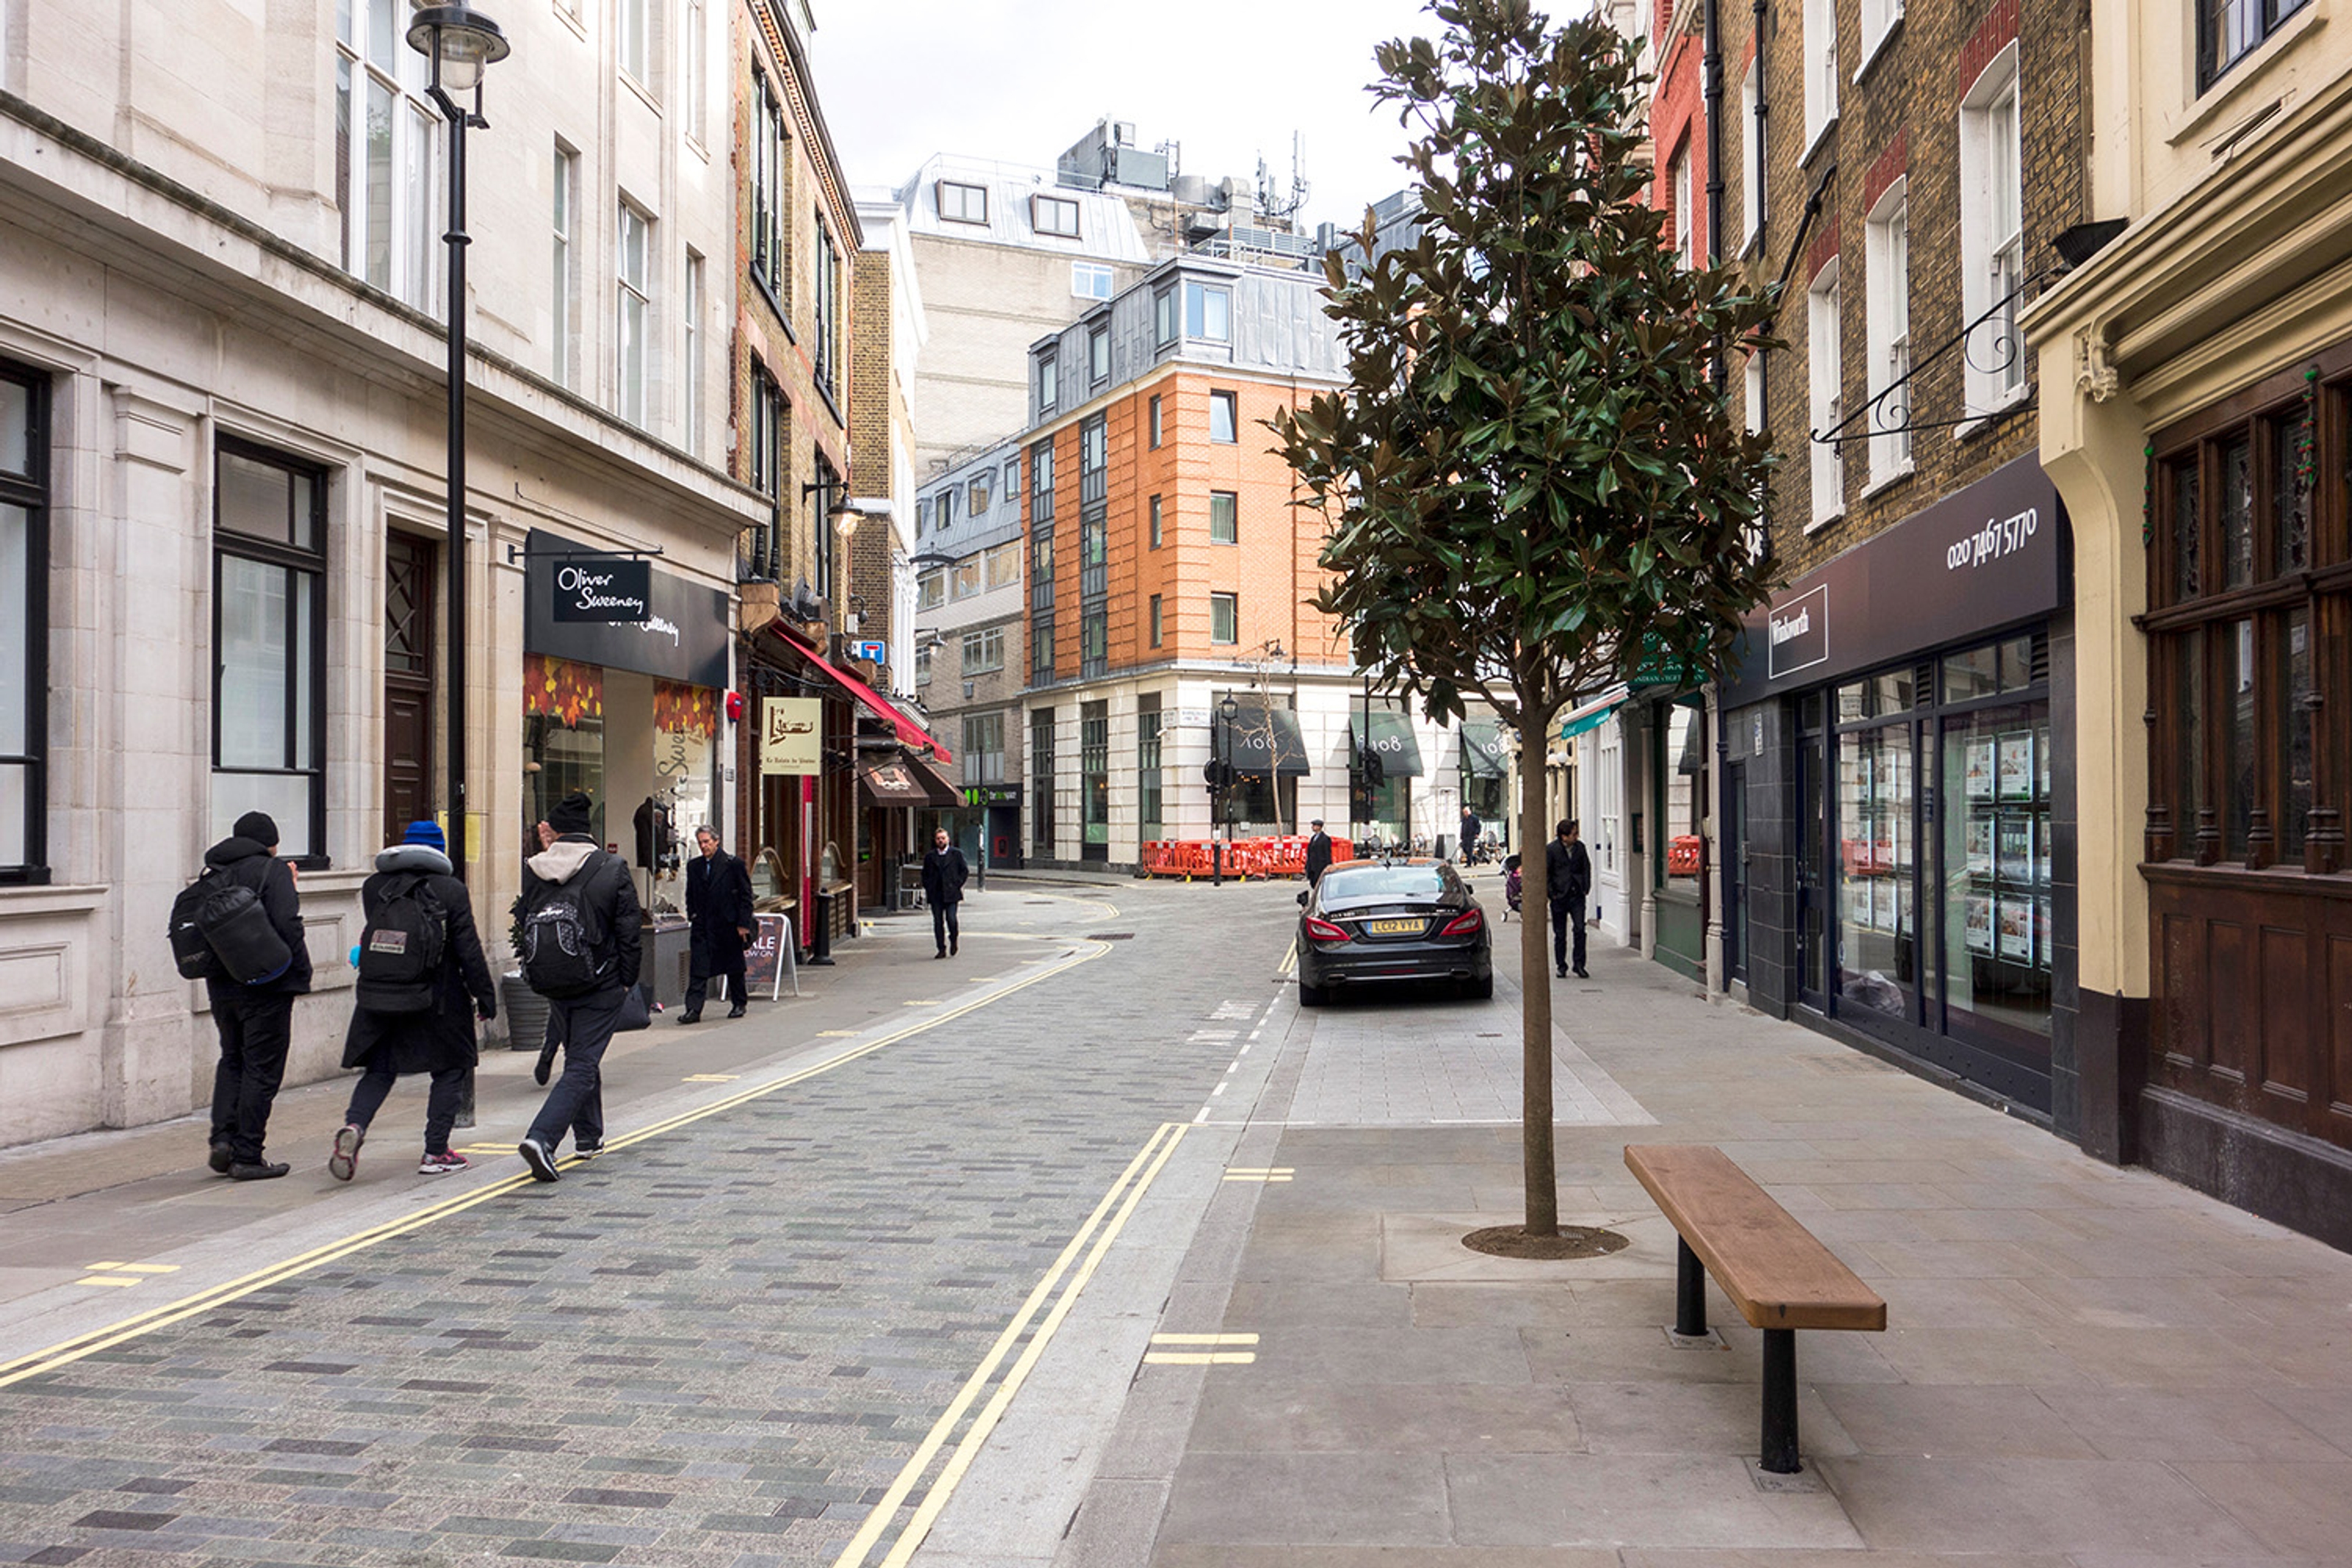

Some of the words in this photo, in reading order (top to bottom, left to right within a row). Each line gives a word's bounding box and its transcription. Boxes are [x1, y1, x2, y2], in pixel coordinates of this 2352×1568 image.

[1947, 539, 1971, 570] 020
[1971, 518, 2002, 567] 7467
[2004, 508, 2037, 554] 5770
[558, 567, 614, 590] Oliver
[575, 586, 643, 614] Sweeney
[1372, 736, 1401, 752] 108
[1375, 921, 1398, 931] LC12
[1400, 920, 1420, 929] VYA
[752, 936, 775, 949] ALE
[744, 949, 760, 957] OW
